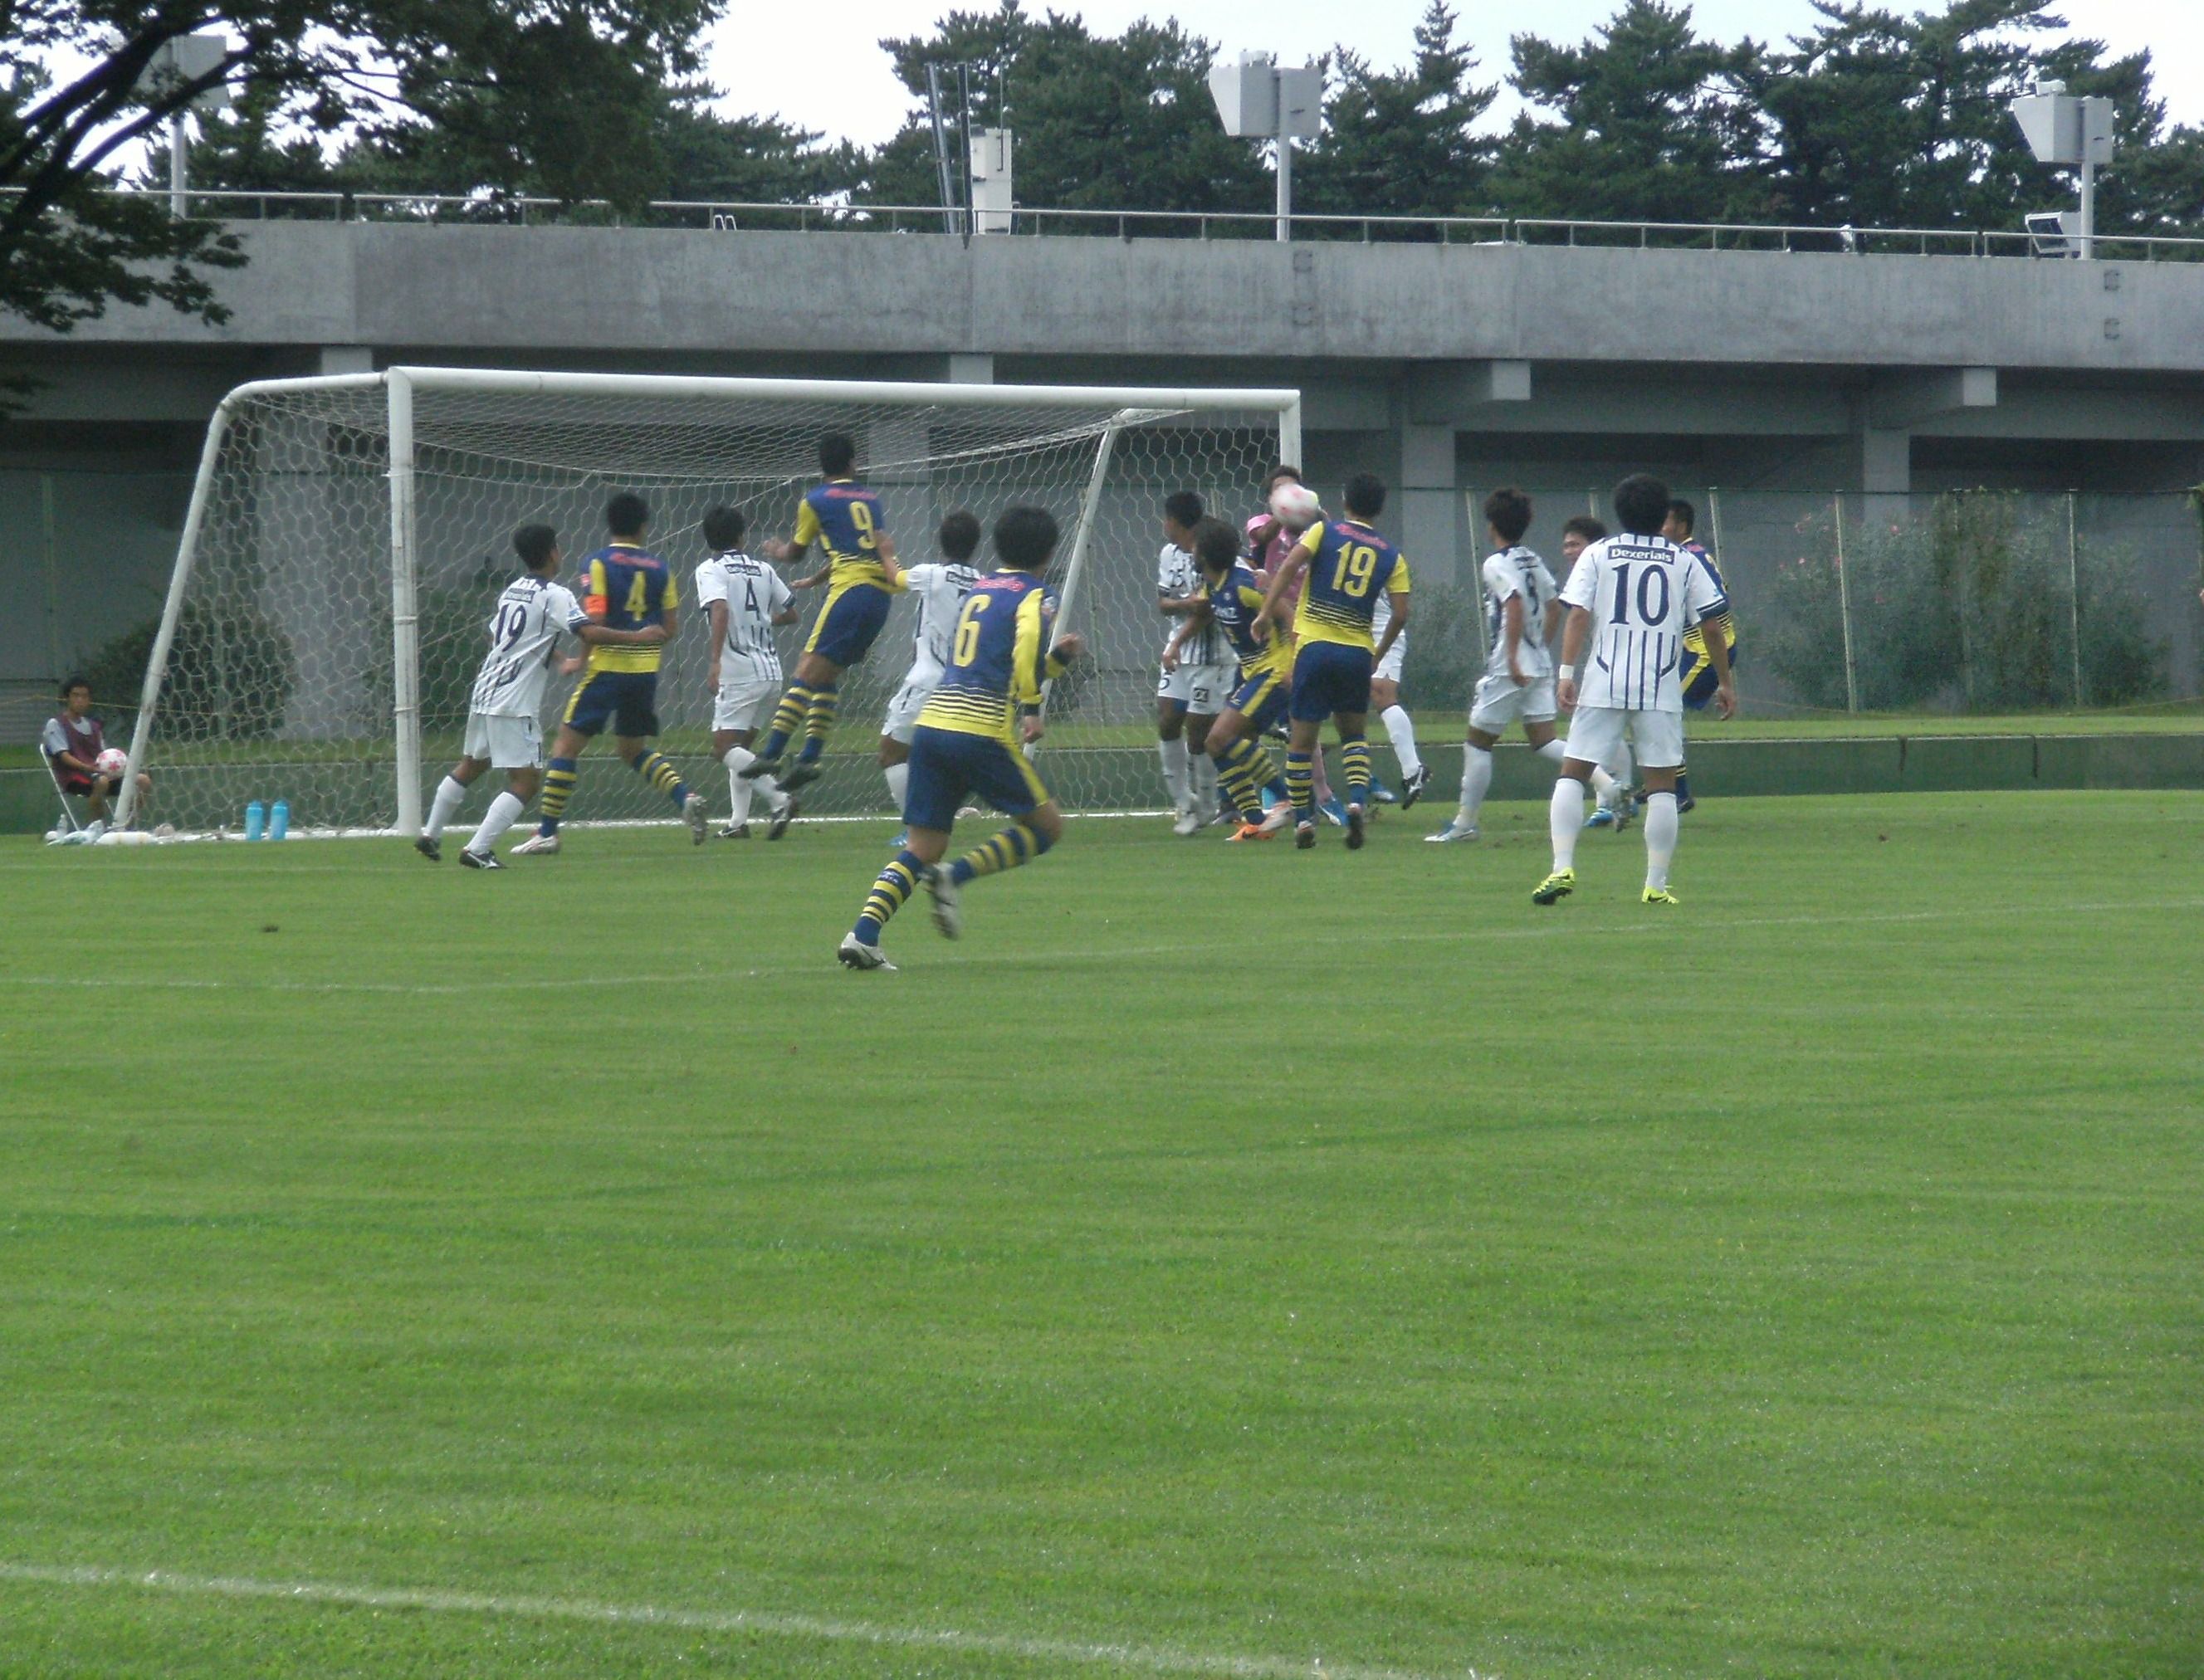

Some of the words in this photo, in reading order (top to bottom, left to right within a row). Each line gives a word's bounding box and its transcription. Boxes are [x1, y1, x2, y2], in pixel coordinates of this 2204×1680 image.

[850, 501, 877, 549] 9
[1332, 540, 1378, 598] 19
[1610, 548, 1673, 562] Dexerials
[624, 570, 648, 622] 4
[745, 578, 760, 621] 4
[1609, 563, 1669, 627] 10
[495, 604, 527, 652] 19
[953, 594, 992, 667] 6
